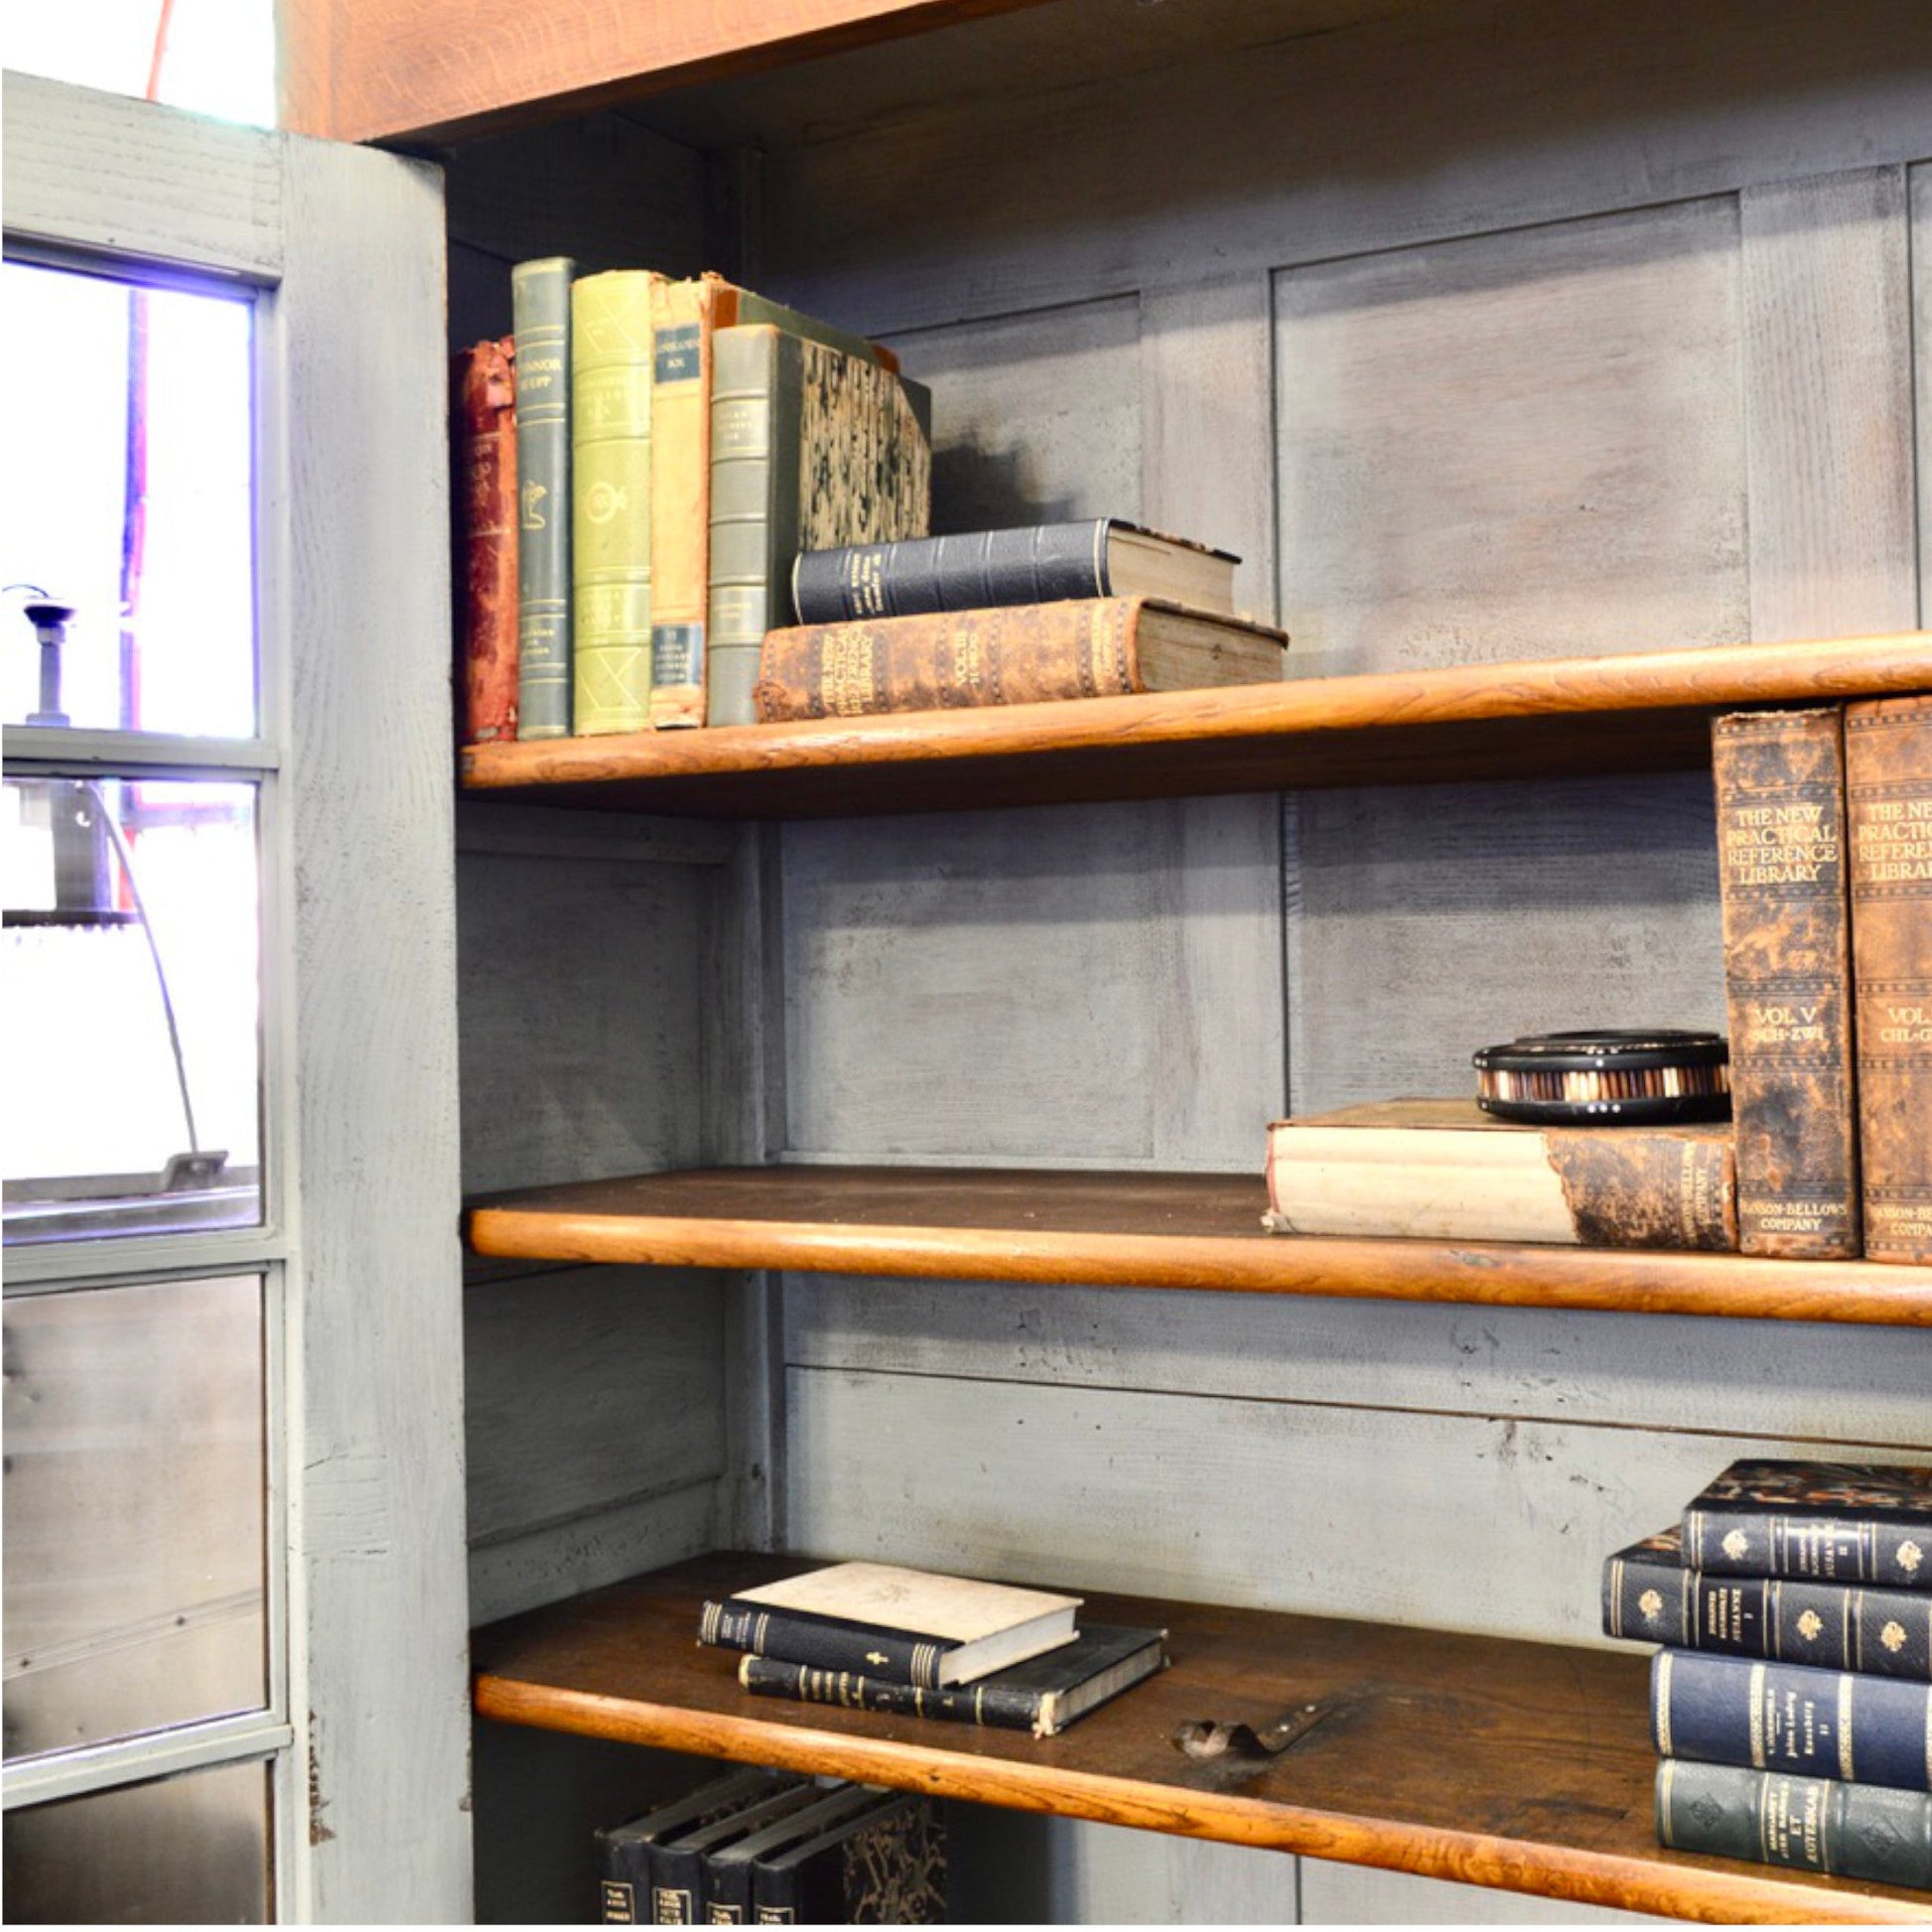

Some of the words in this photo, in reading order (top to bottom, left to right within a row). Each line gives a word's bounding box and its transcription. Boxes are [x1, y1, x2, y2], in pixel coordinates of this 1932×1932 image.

[860, 635, 873, 702] LIBRARY
[1735, 808, 1773, 828] THE
[1775, 805, 1824, 824] NEW
[1867, 801, 1905, 823] THE
[1725, 824, 1838, 847] PRACTICAL
[1727, 843, 1838, 867] REFERENCE
[1738, 864, 1822, 884] LIBRARY
[1869, 861, 1932, 882] LIBRA
[1799, 1006, 1818, 1025] V
[1760, 1216, 1823, 1232] COMPANY
[1789, 1815, 1803, 1838] ET
